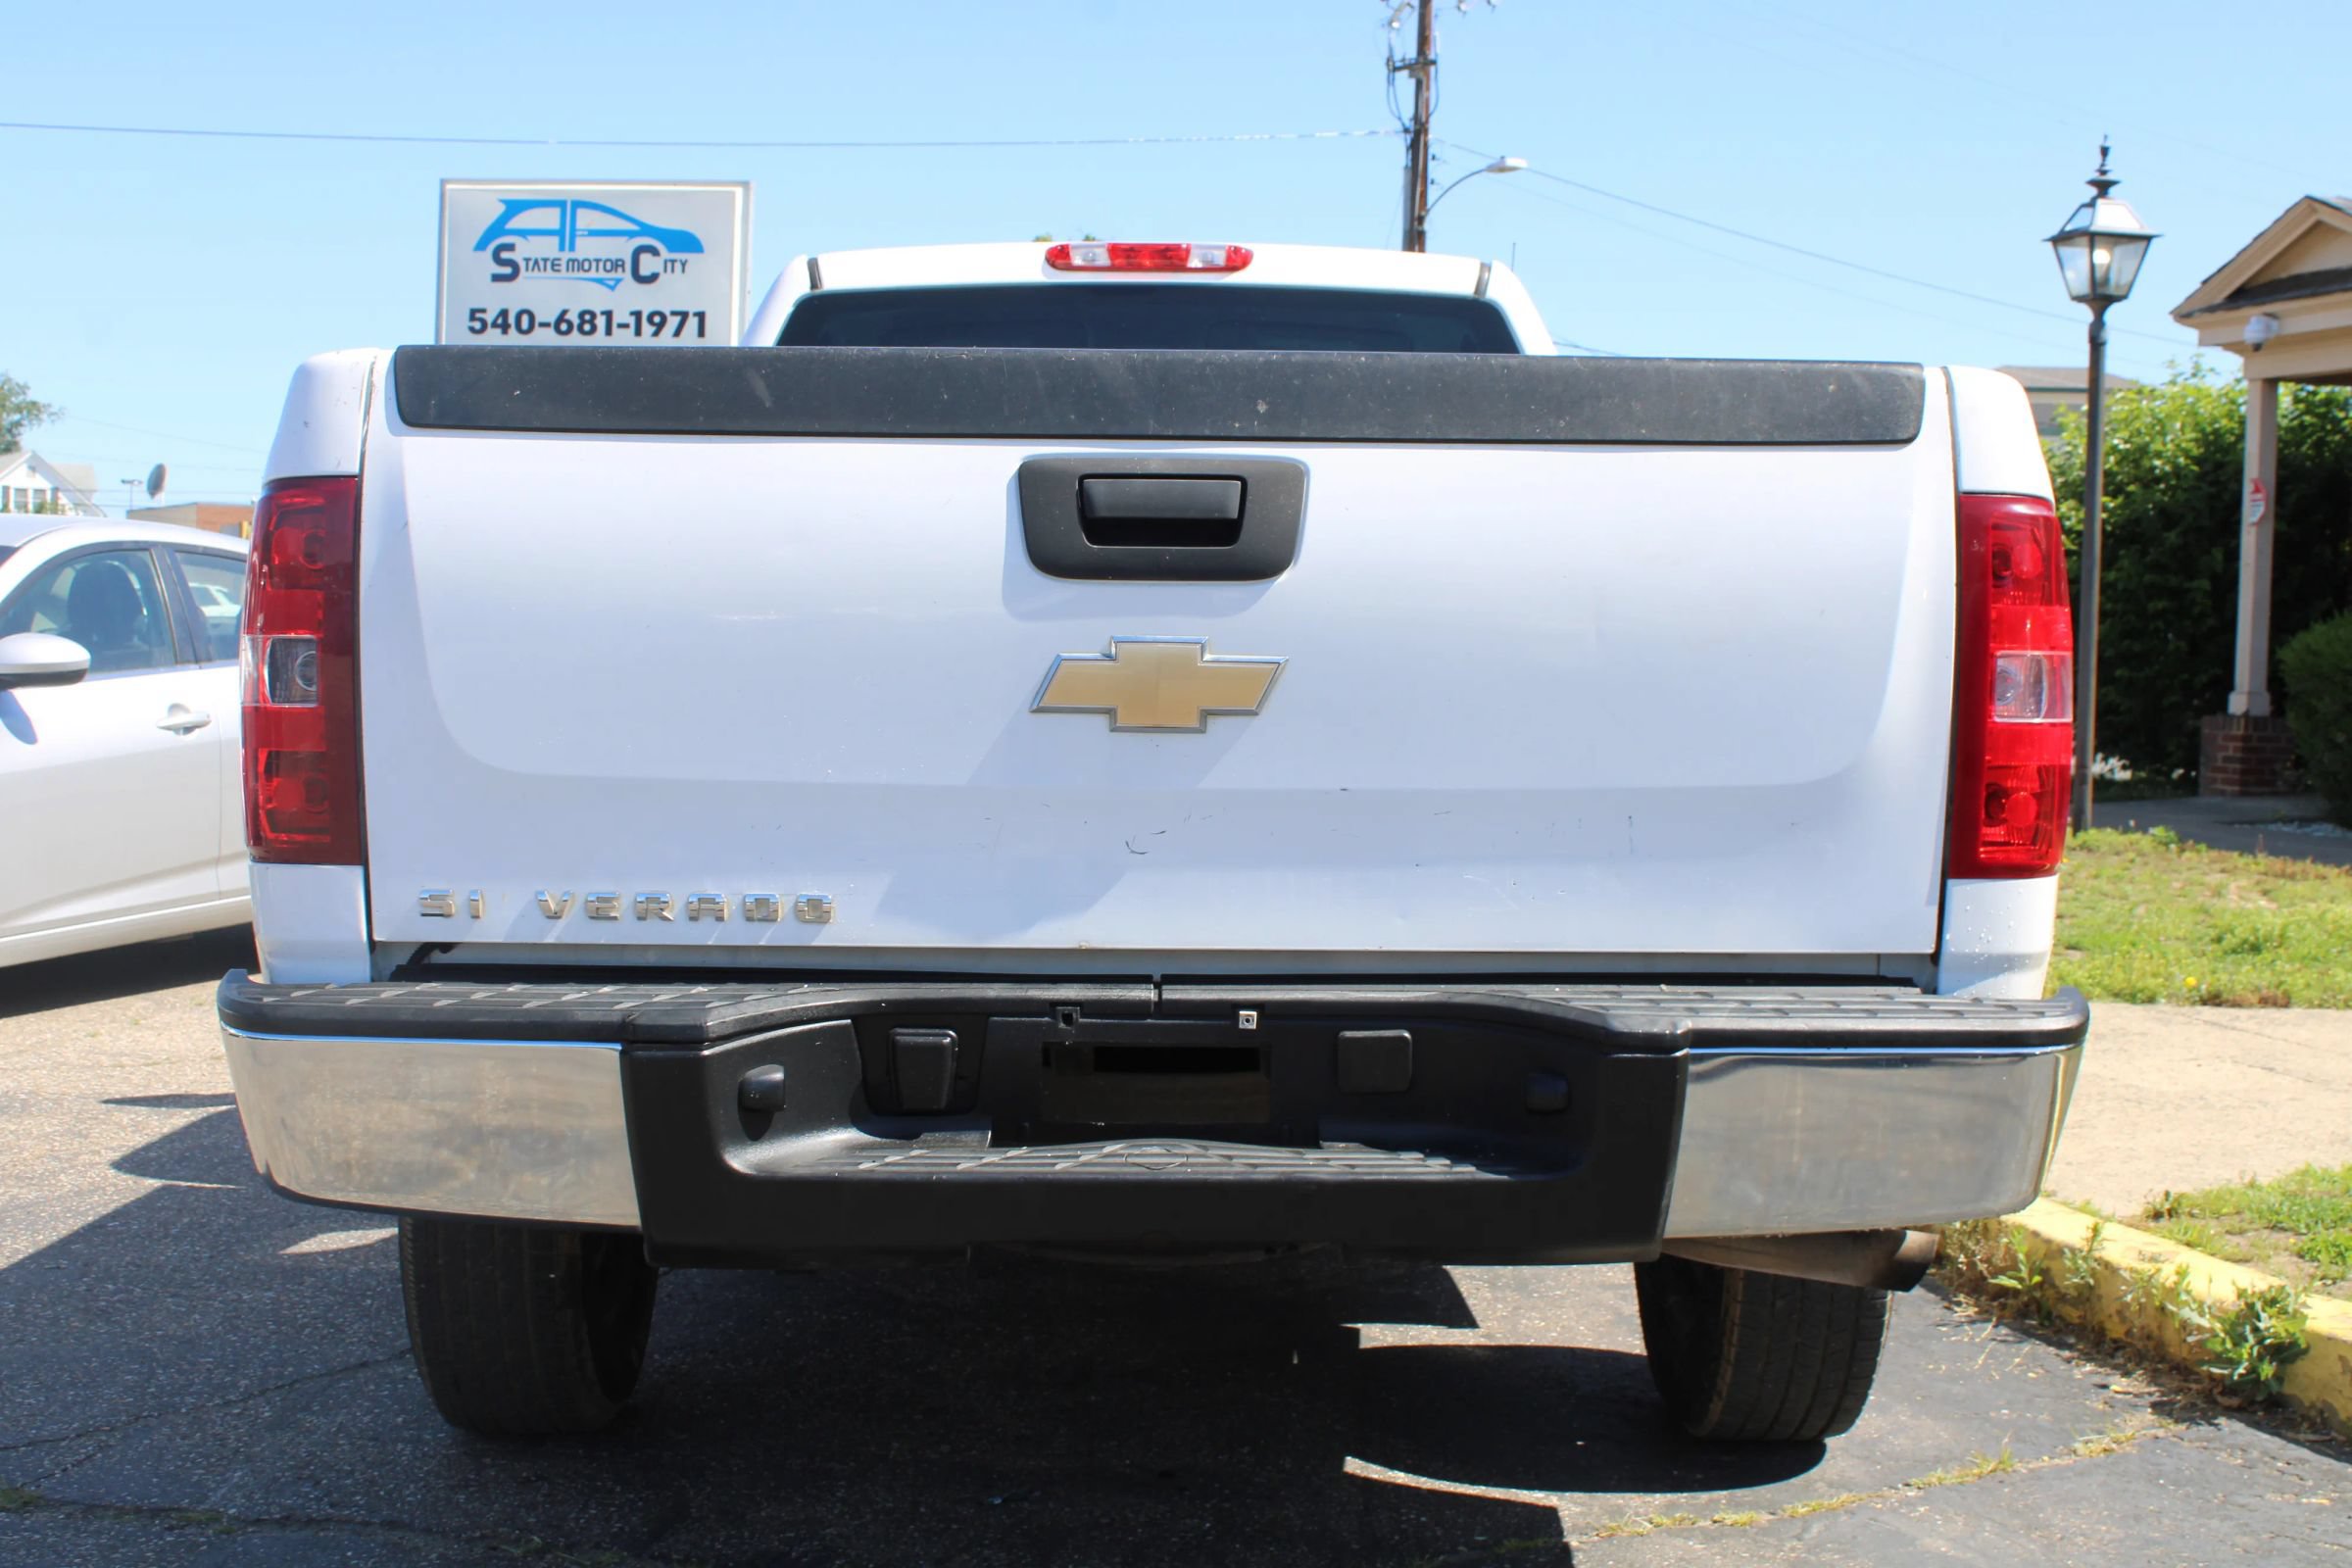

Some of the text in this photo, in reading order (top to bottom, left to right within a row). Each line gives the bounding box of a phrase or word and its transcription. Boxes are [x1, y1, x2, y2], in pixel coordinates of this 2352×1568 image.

[491, 243, 689, 284] STATE MOTOR CITY
[466, 308, 707, 338] 540-681-1971
